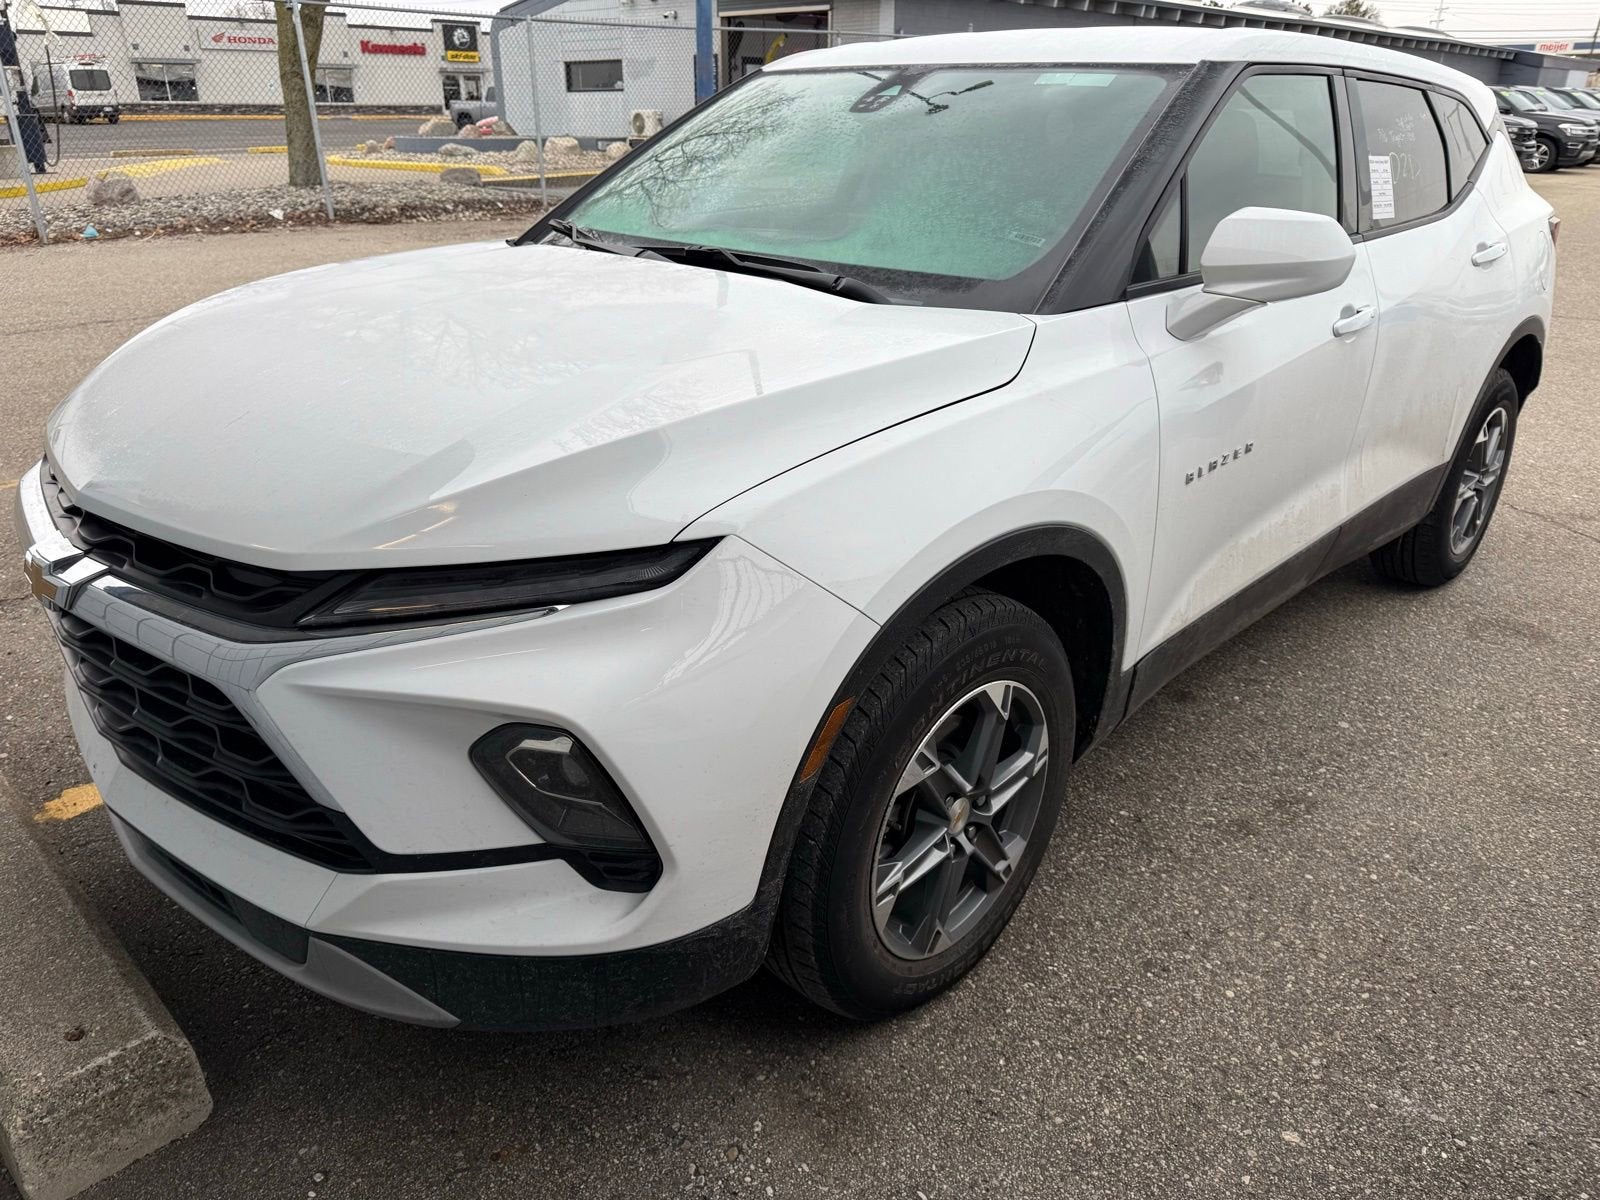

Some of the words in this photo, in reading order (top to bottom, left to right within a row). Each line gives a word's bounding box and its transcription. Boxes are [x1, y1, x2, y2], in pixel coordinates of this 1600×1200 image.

[227, 36, 275, 45] HONDA
[360, 40, 426, 56] Kawasaki
[1540, 43, 1569, 53] meijer
[1184, 442, 1254, 486] BLAZER
